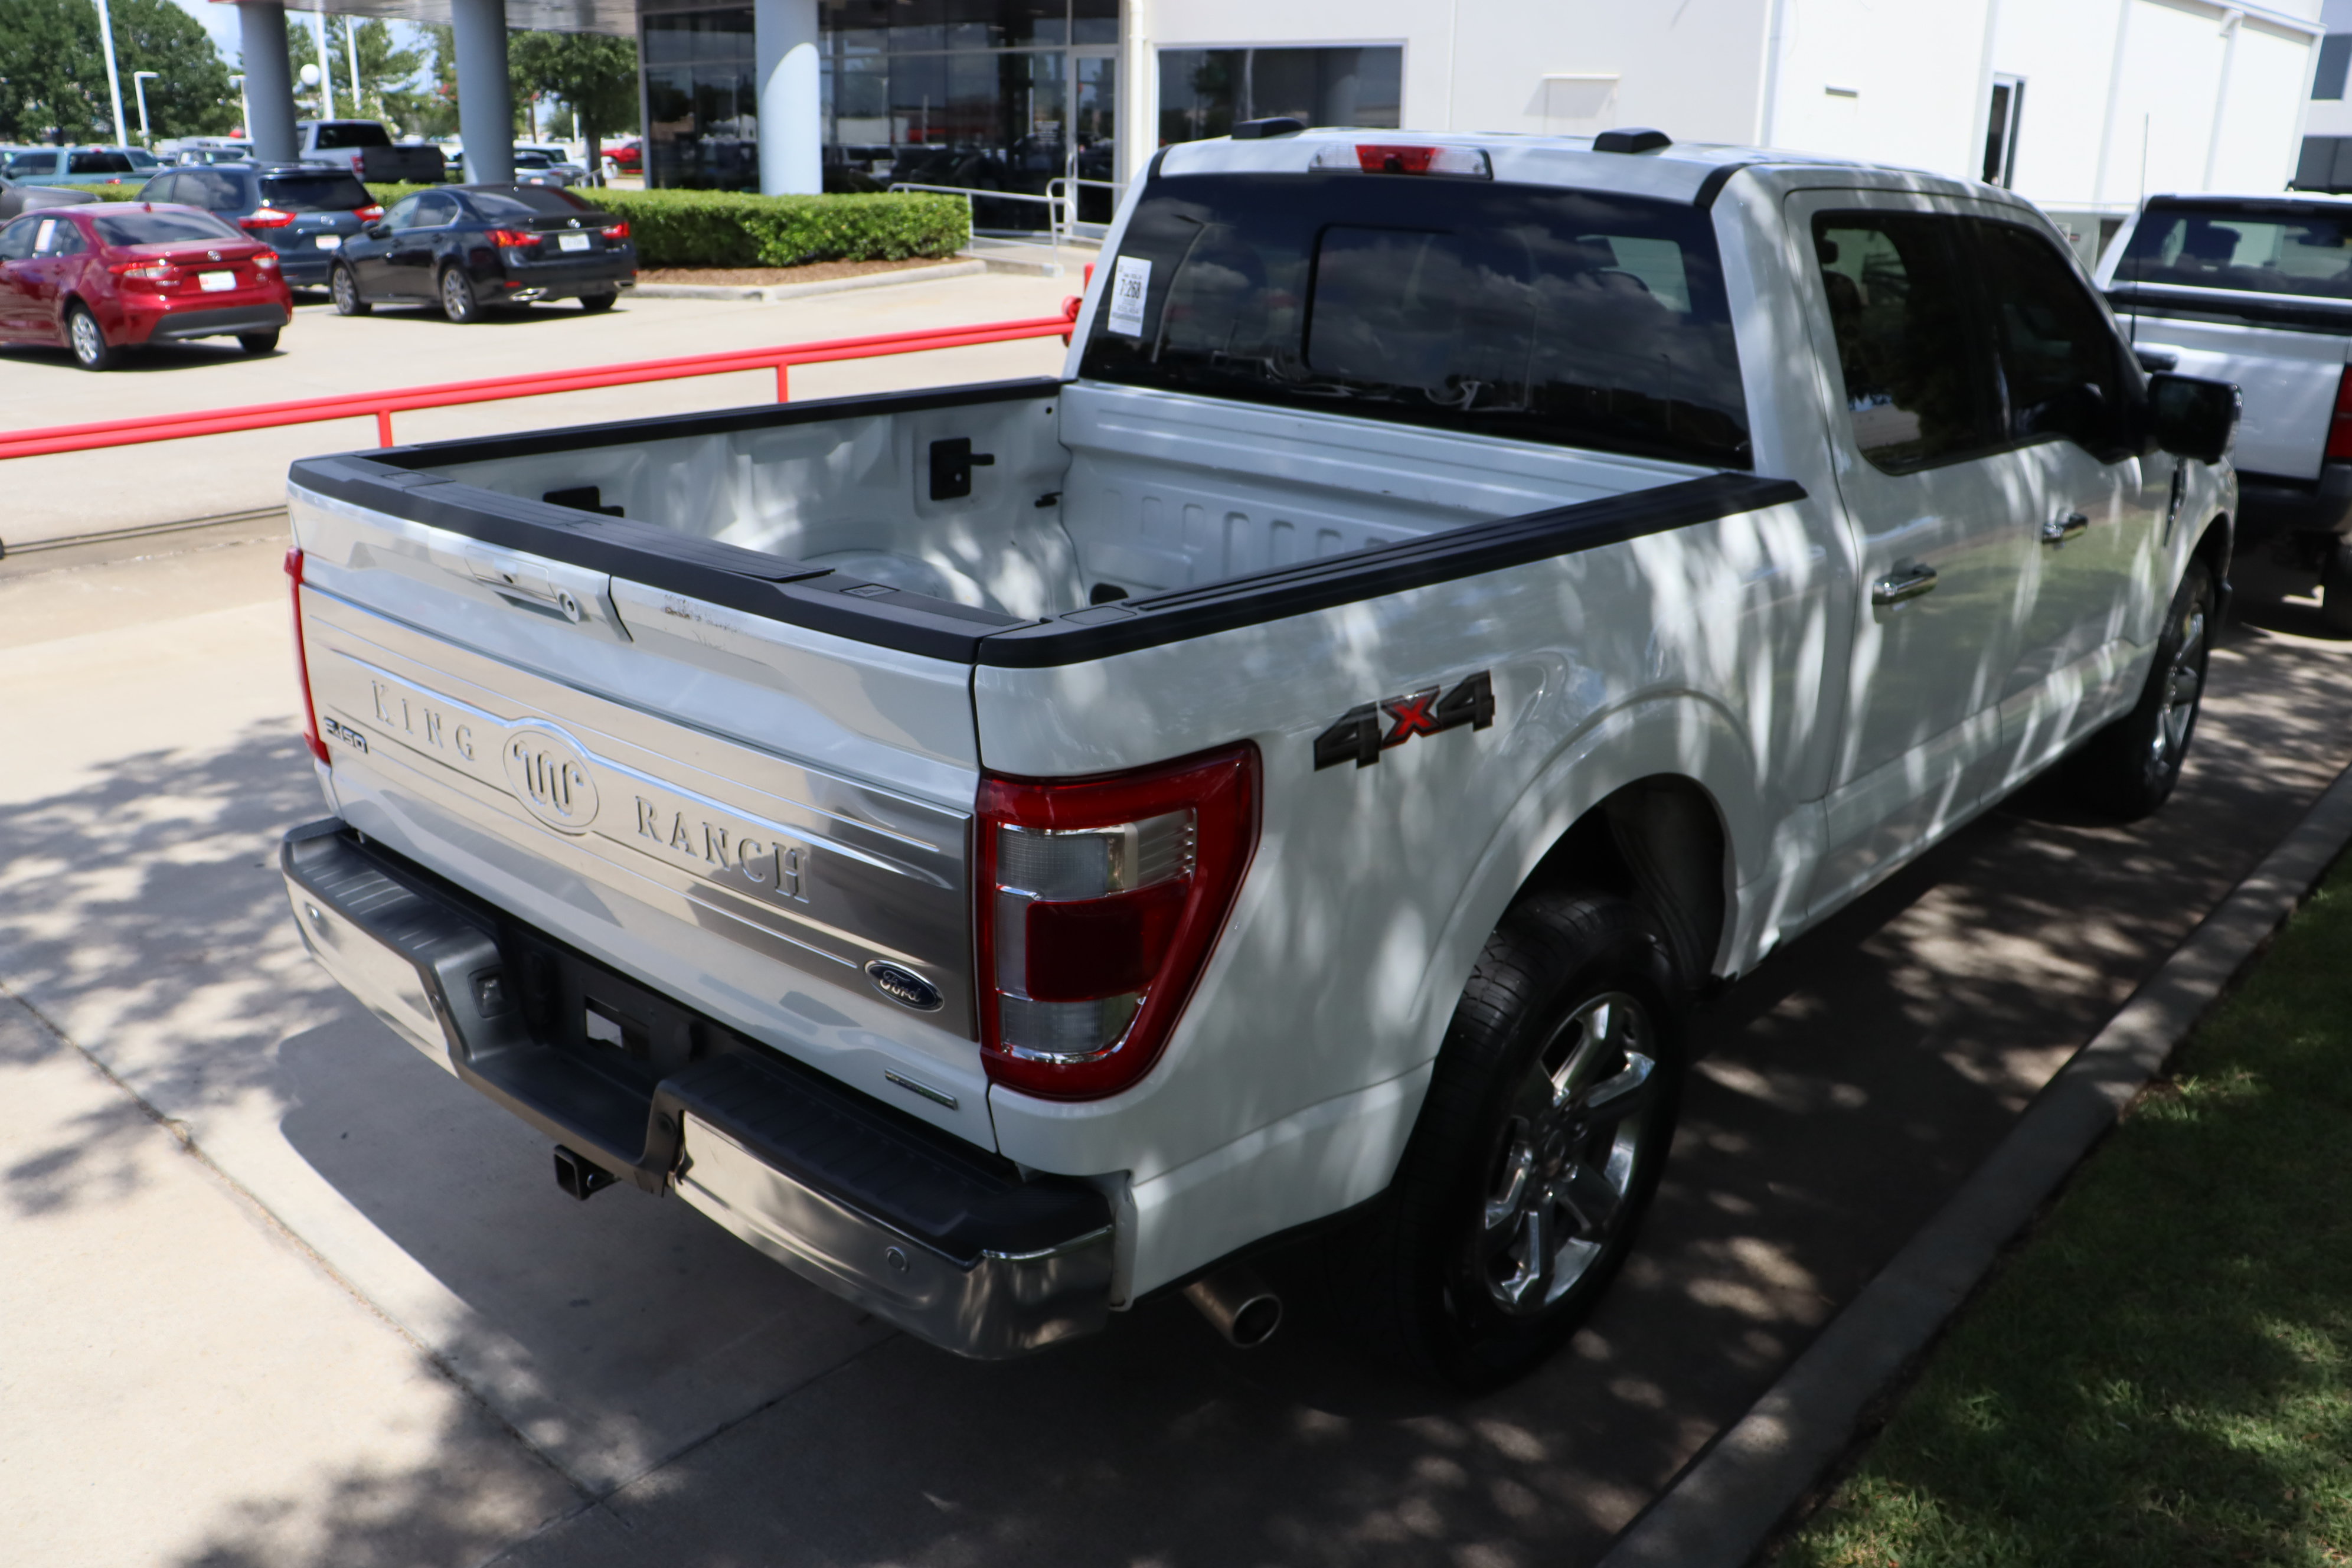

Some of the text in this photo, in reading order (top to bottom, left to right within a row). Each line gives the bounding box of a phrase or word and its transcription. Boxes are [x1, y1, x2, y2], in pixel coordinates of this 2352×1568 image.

[371, 680, 475, 762] KING
[635, 795, 811, 904] RANCH
[880, 970, 922, 1003] Ford
